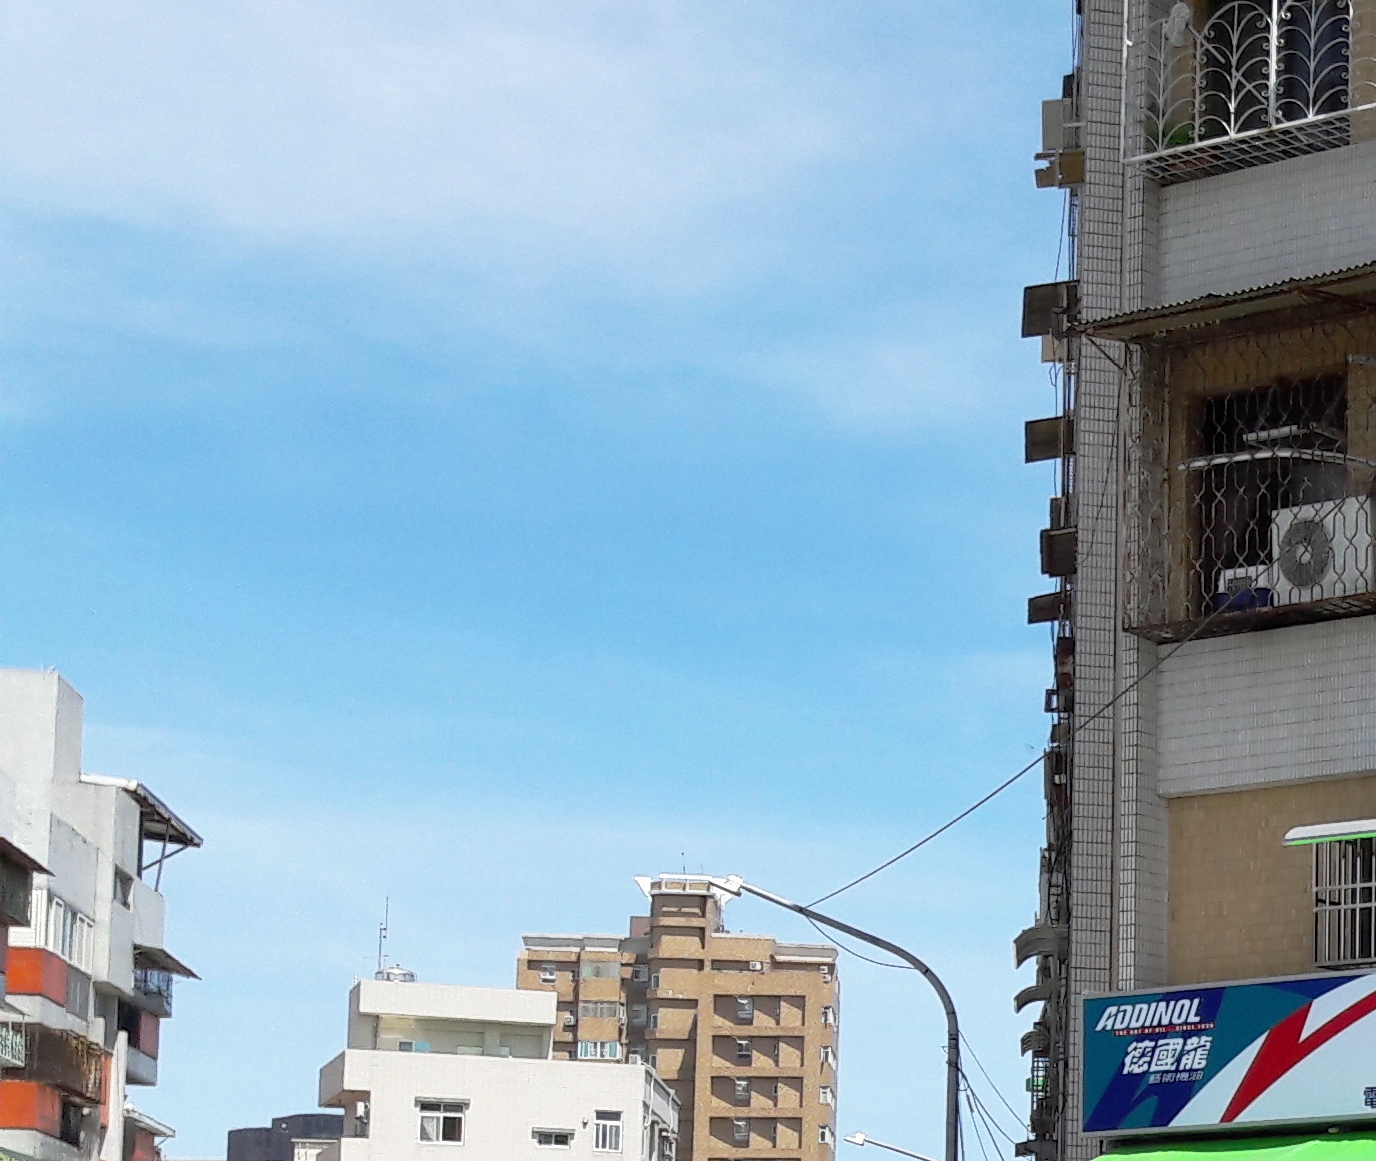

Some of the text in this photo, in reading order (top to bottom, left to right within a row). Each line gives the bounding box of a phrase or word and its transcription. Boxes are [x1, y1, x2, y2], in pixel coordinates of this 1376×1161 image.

[1095, 997, 1201, 1031] ADDINOL
[1121, 1035, 1213, 1075] 德國龍
